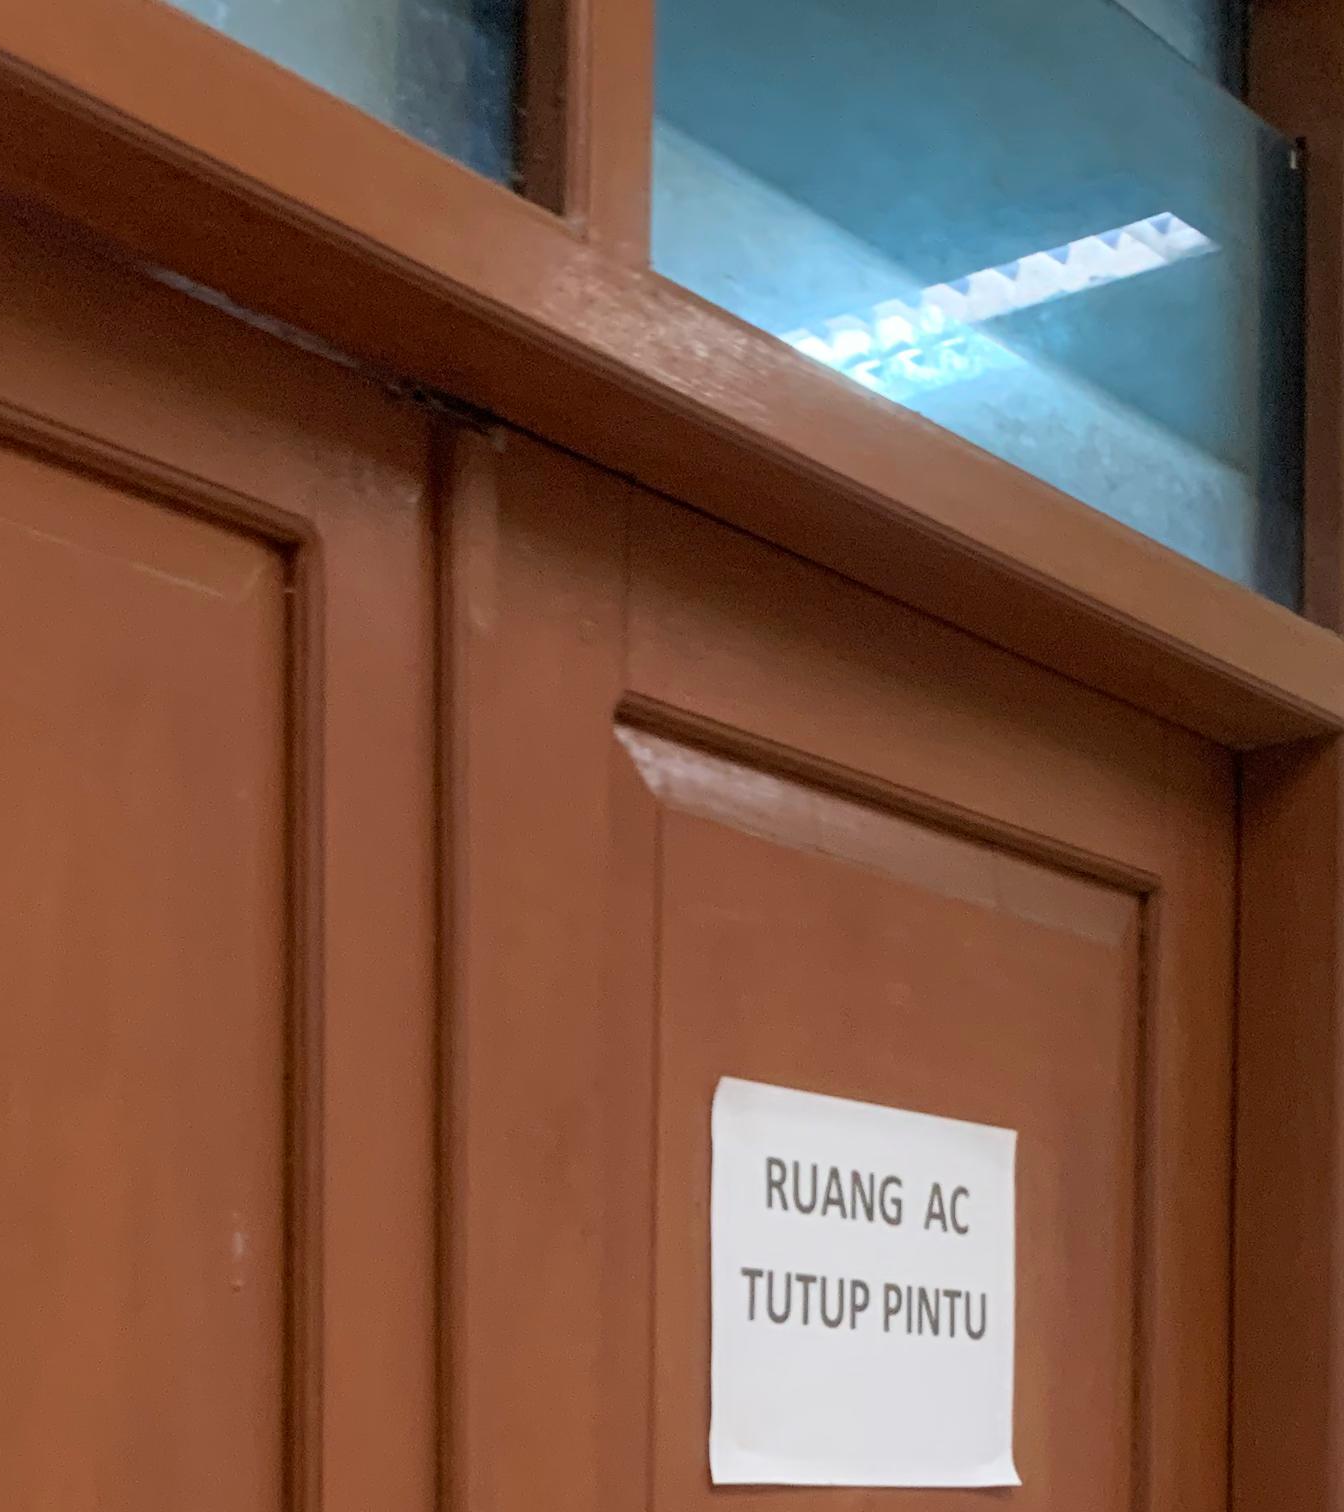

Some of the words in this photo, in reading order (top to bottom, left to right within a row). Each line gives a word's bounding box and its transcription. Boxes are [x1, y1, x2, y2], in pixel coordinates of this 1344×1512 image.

[764, 1156, 904, 1227] RUANG
[923, 1182, 970, 1236] AC
[741, 1267, 871, 1330] TUTUP
[882, 1282, 988, 1341] PINTU
